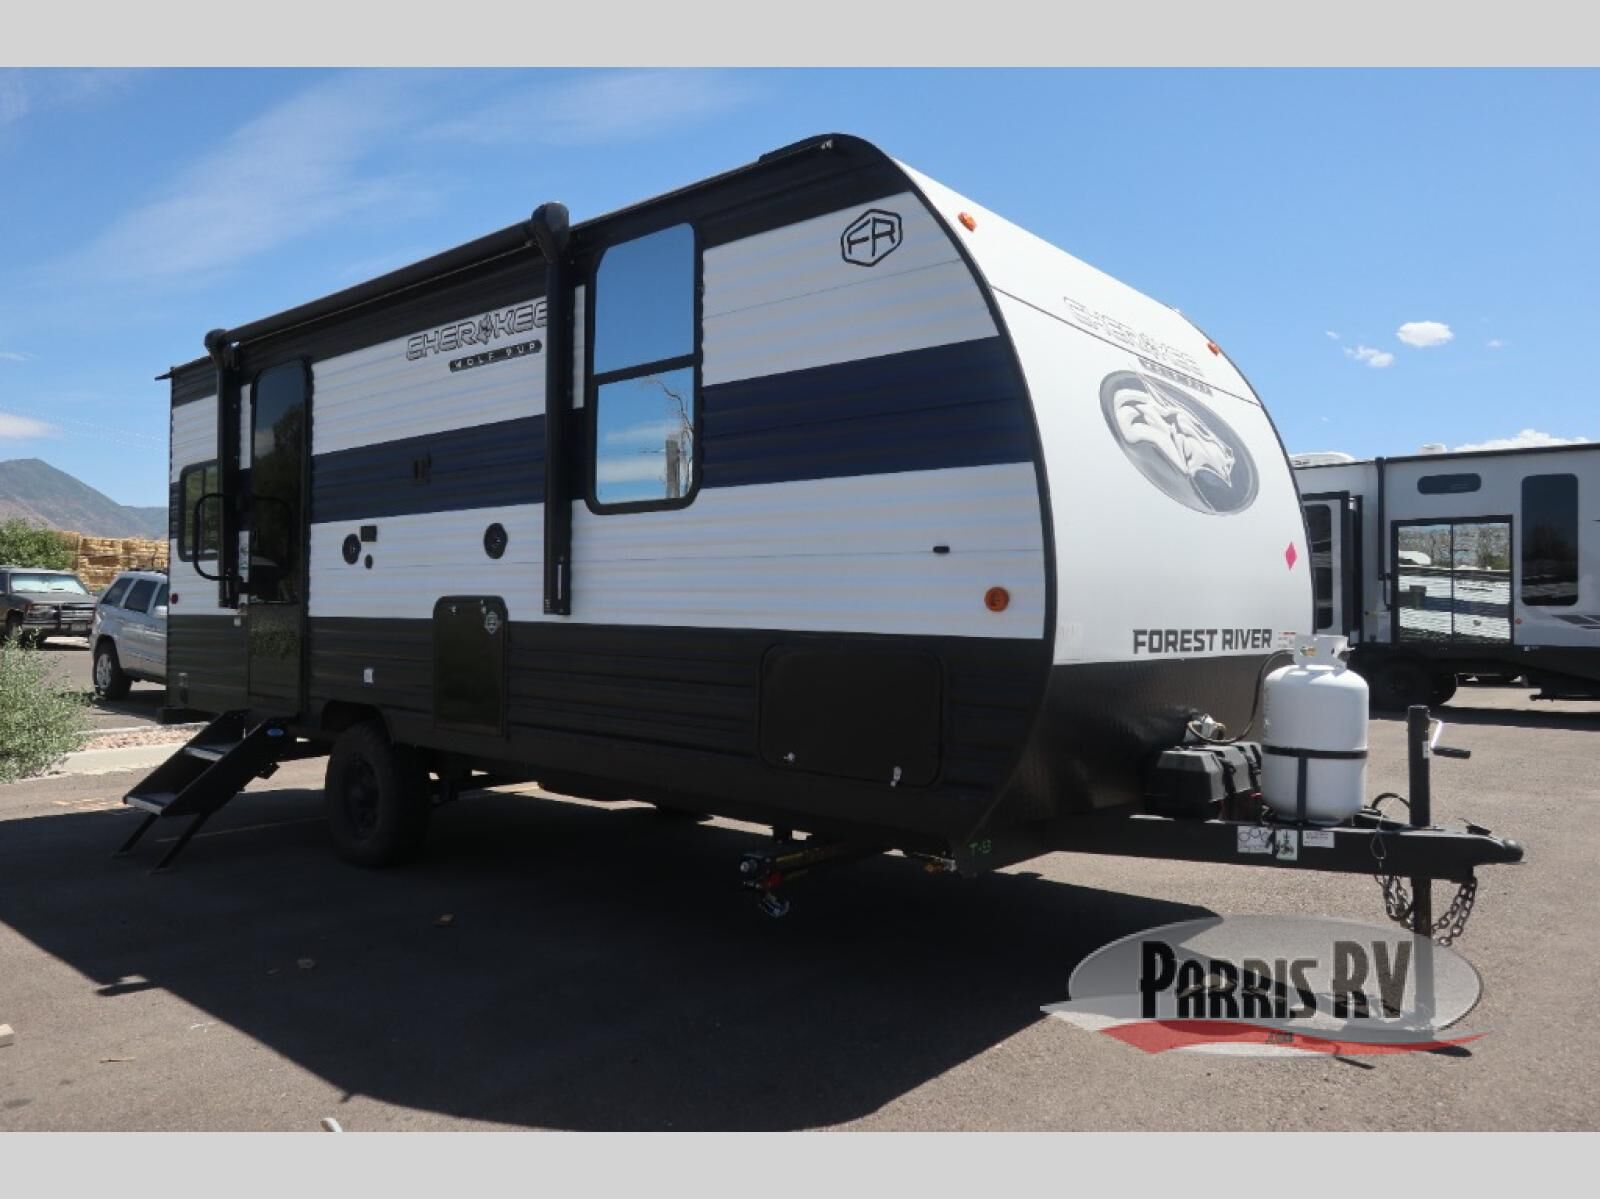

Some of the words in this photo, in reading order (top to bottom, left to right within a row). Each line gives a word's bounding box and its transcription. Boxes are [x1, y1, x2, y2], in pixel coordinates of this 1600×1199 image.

[847, 217, 896, 257] FR
[1132, 628, 1218, 654] FOREST
[1221, 628, 1272, 651] RIVER
